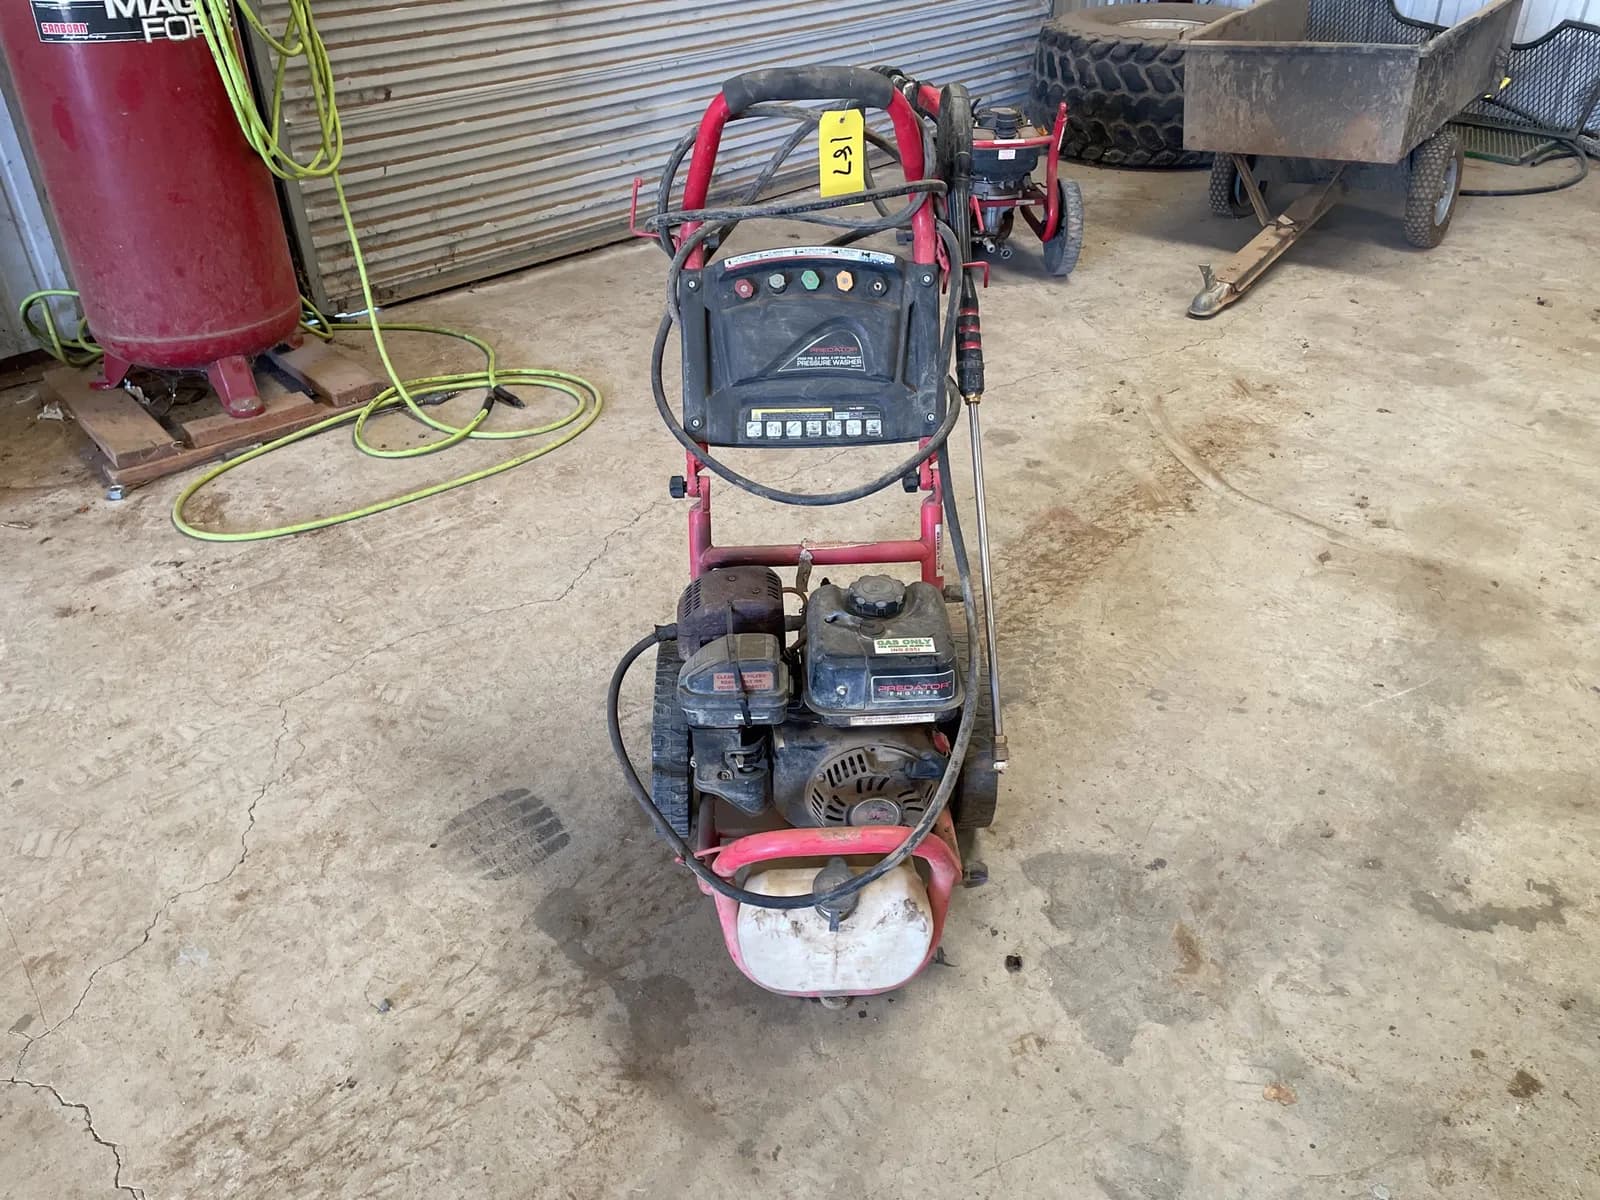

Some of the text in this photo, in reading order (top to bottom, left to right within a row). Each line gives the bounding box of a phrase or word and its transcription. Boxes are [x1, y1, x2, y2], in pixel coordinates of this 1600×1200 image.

[104, 0, 197, 19] MAG
[42, 23, 87, 34] SANBORN
[141, 14, 205, 43] FOR
[796, 359, 832, 367] PRESSURE
[832, 358, 862, 366] WASHER
[877, 680, 952, 692] PREDATOR
[888, 689, 939, 697] ENGINES
